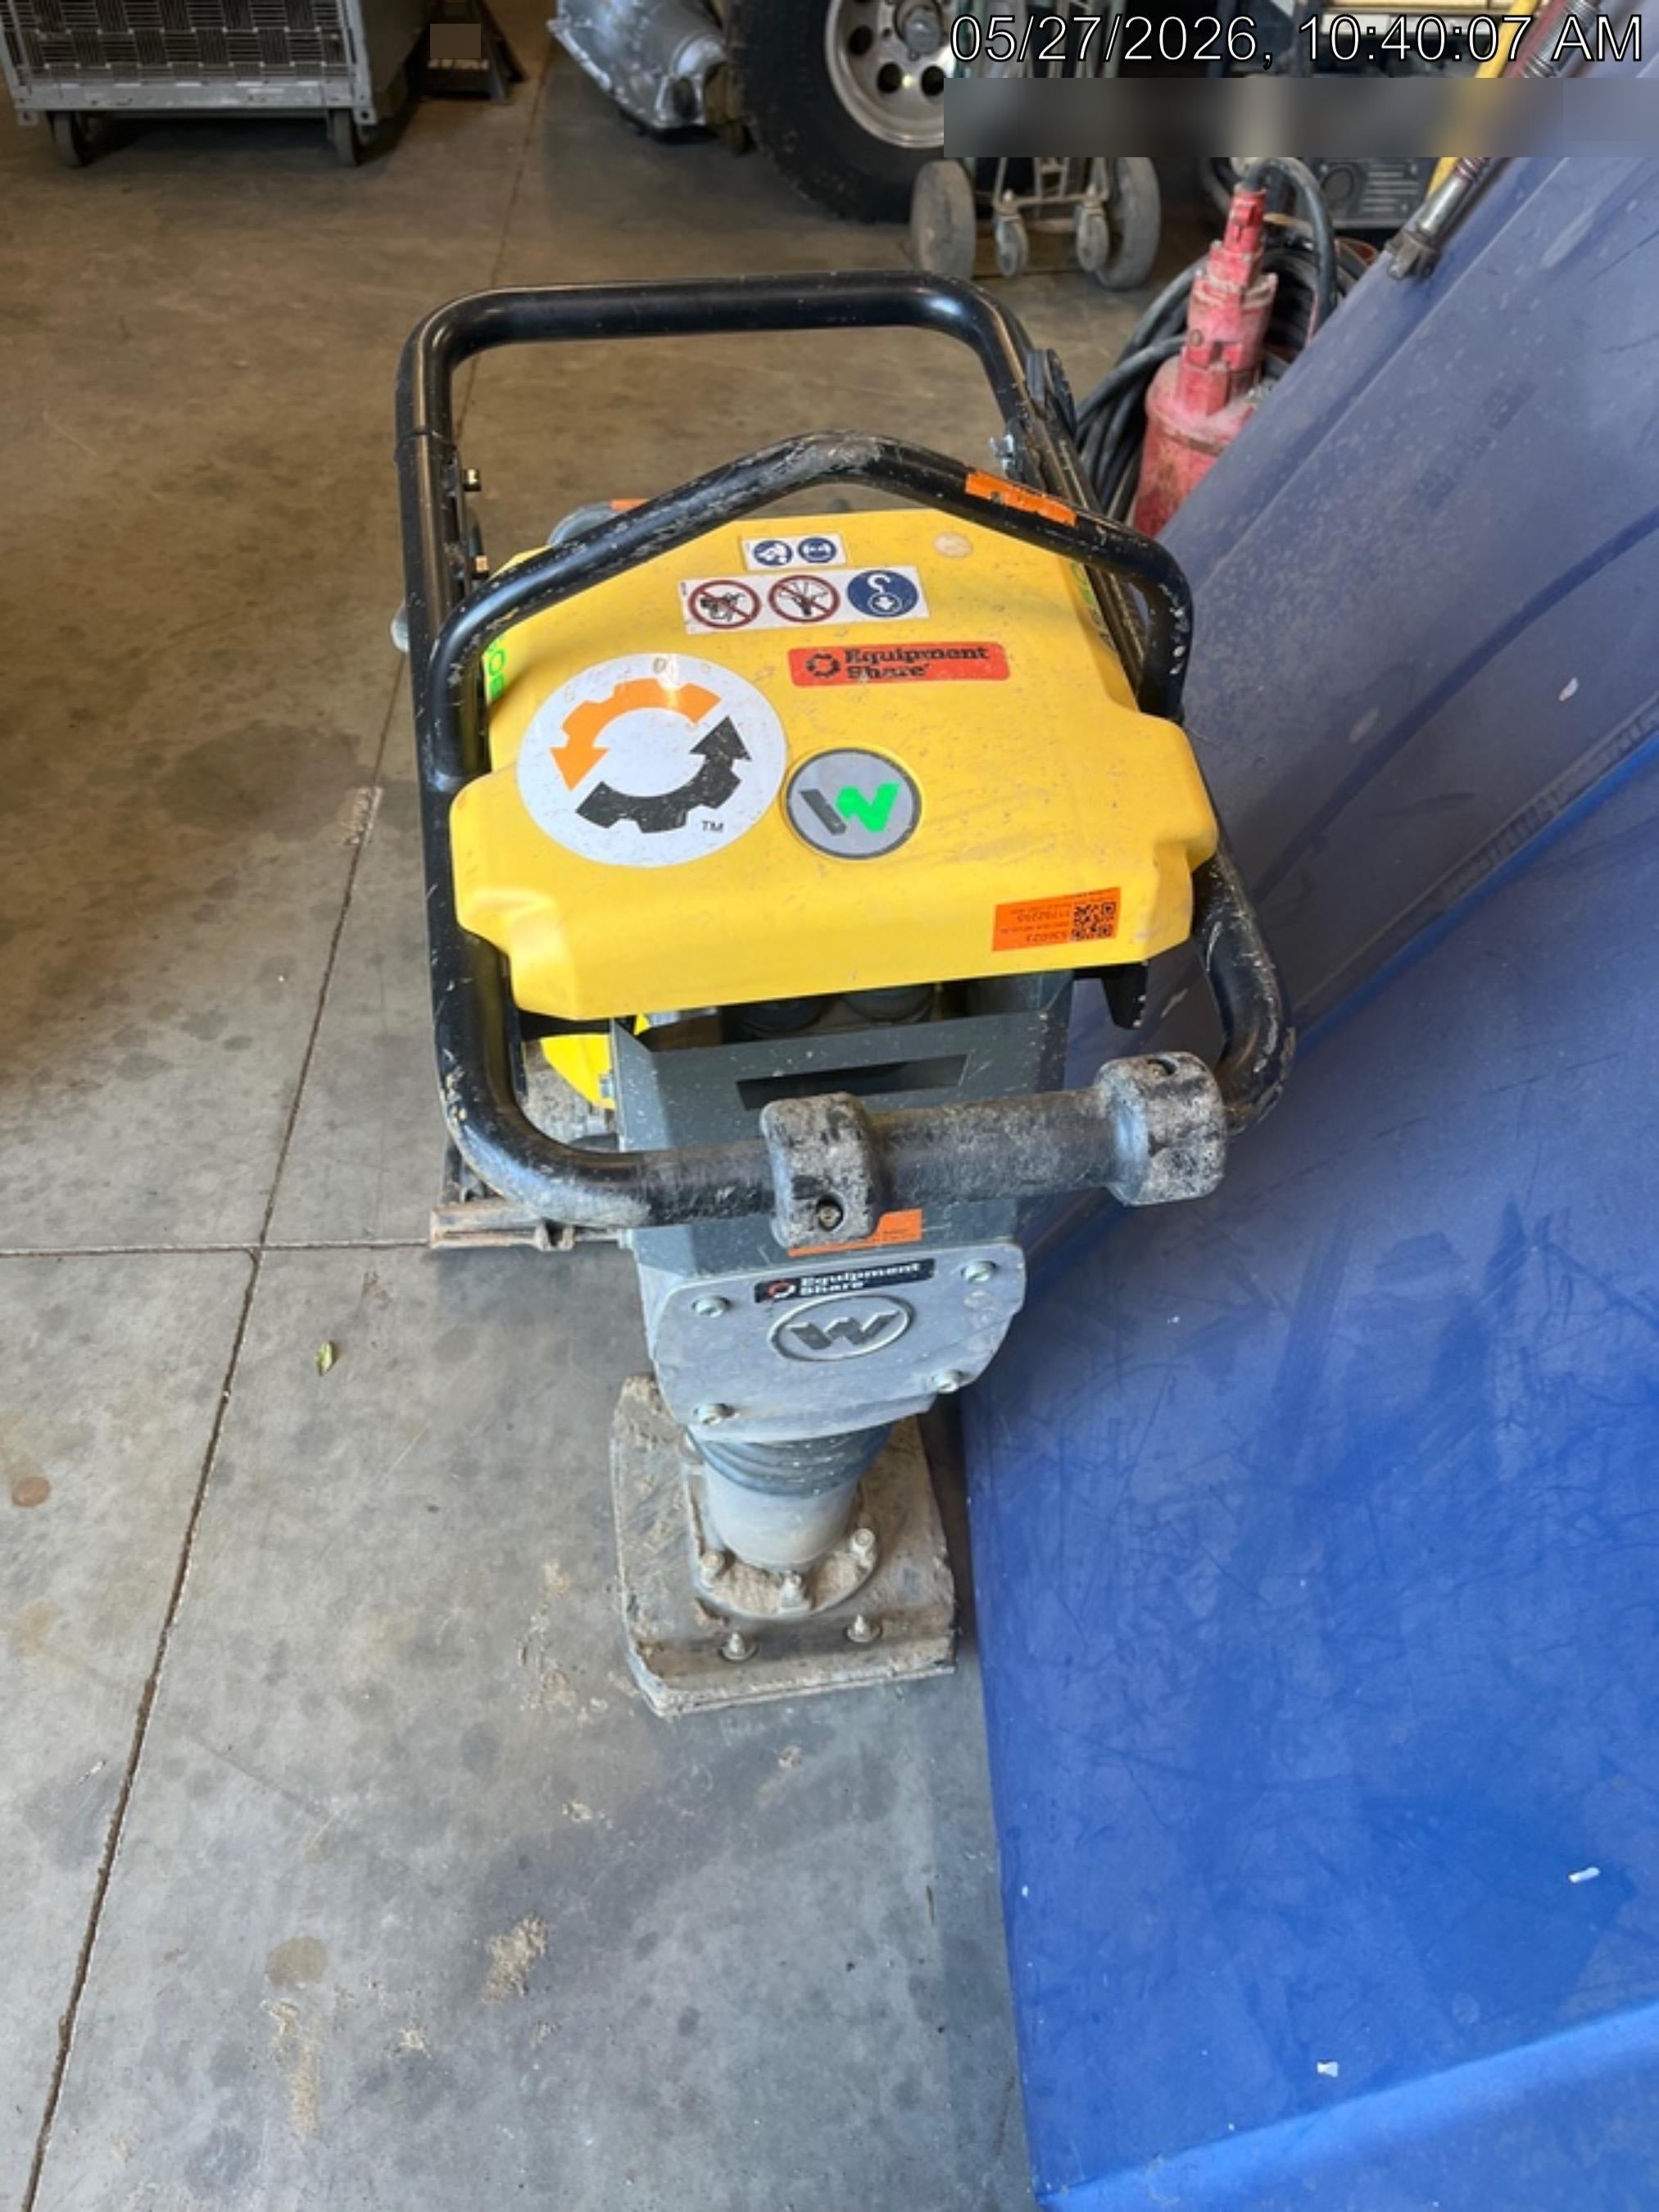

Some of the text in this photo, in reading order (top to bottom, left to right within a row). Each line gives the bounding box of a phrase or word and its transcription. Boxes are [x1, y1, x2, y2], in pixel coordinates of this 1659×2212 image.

[845, 646, 988, 664] Equipment
[847, 664, 926, 679] Share
[800, 1262, 920, 1286] Equipment
